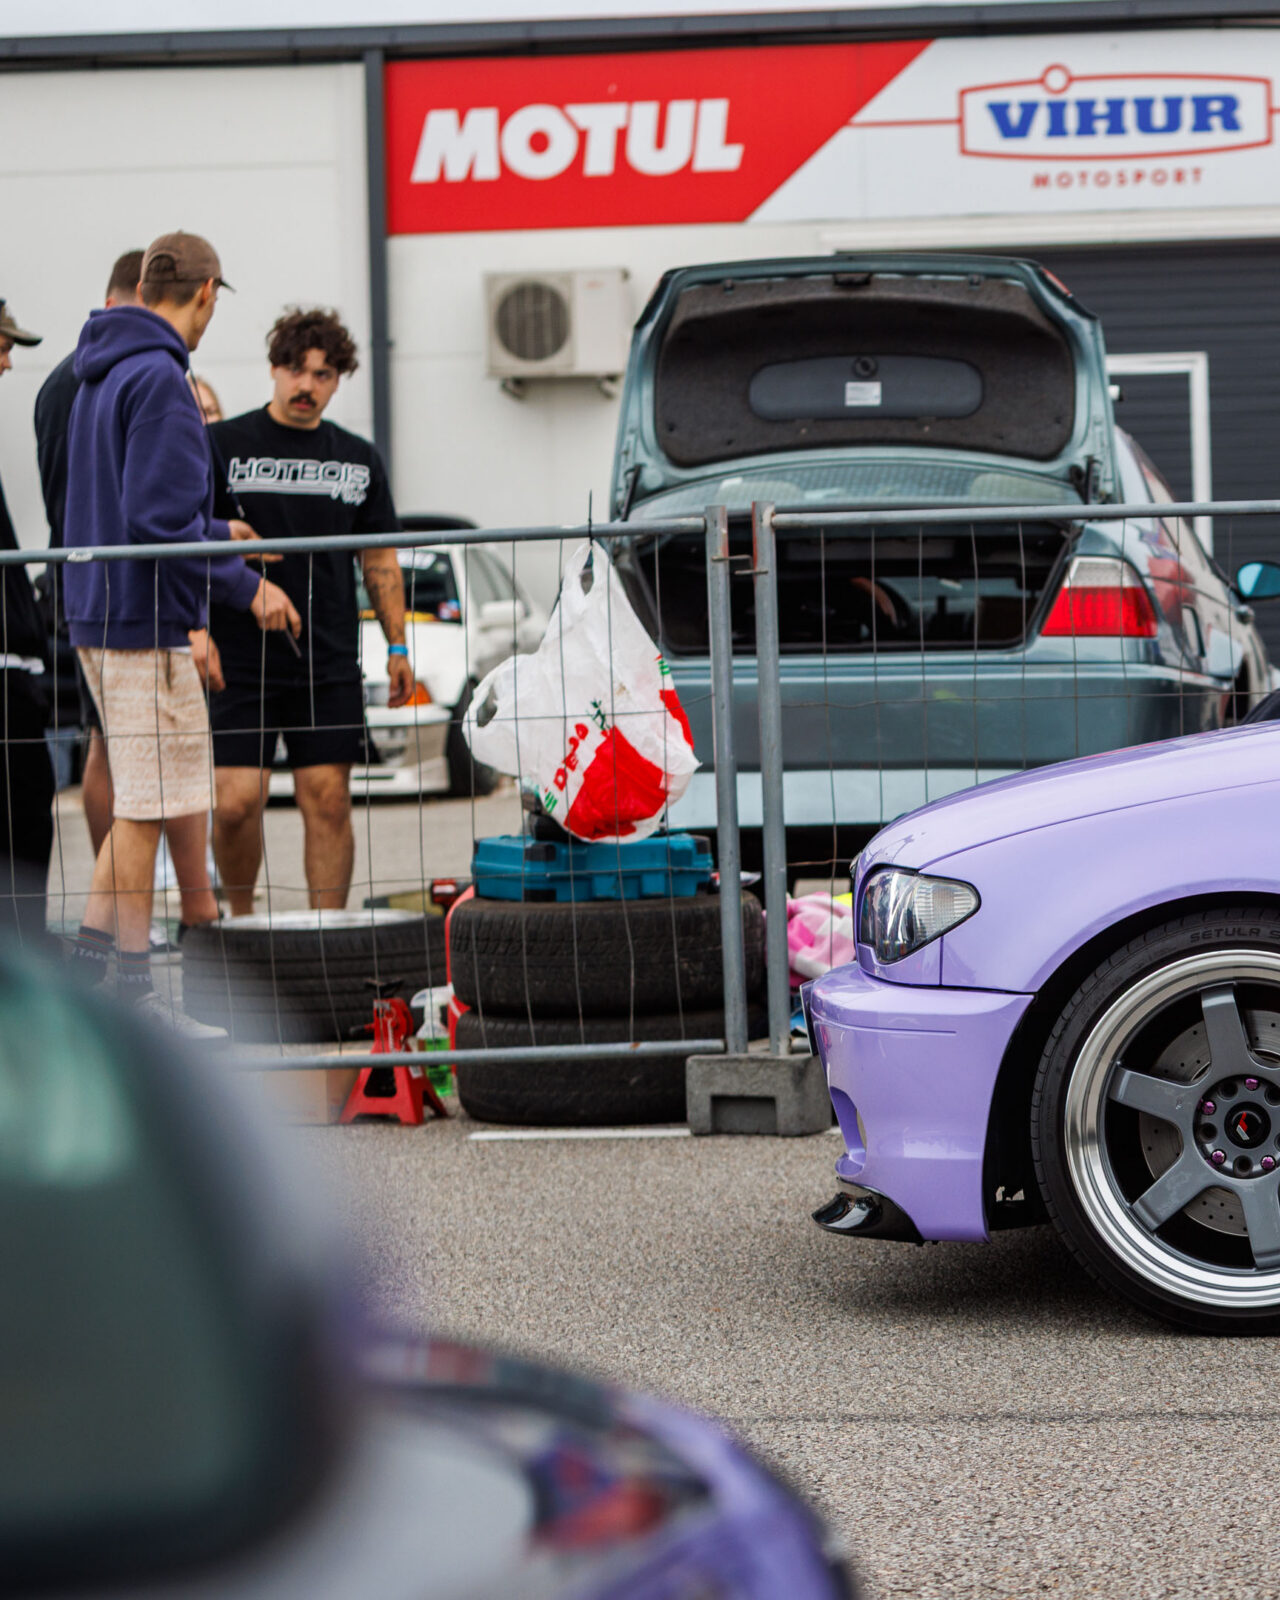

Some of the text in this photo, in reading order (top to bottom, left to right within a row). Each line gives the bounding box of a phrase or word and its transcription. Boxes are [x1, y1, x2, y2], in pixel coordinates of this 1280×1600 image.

[987, 94, 1242, 139] VIHUR
[410, 98, 744, 184] MOTUL
[1032, 167, 1204, 189] MOTOSPORT
[228, 456, 371, 488] HOTBOIS
